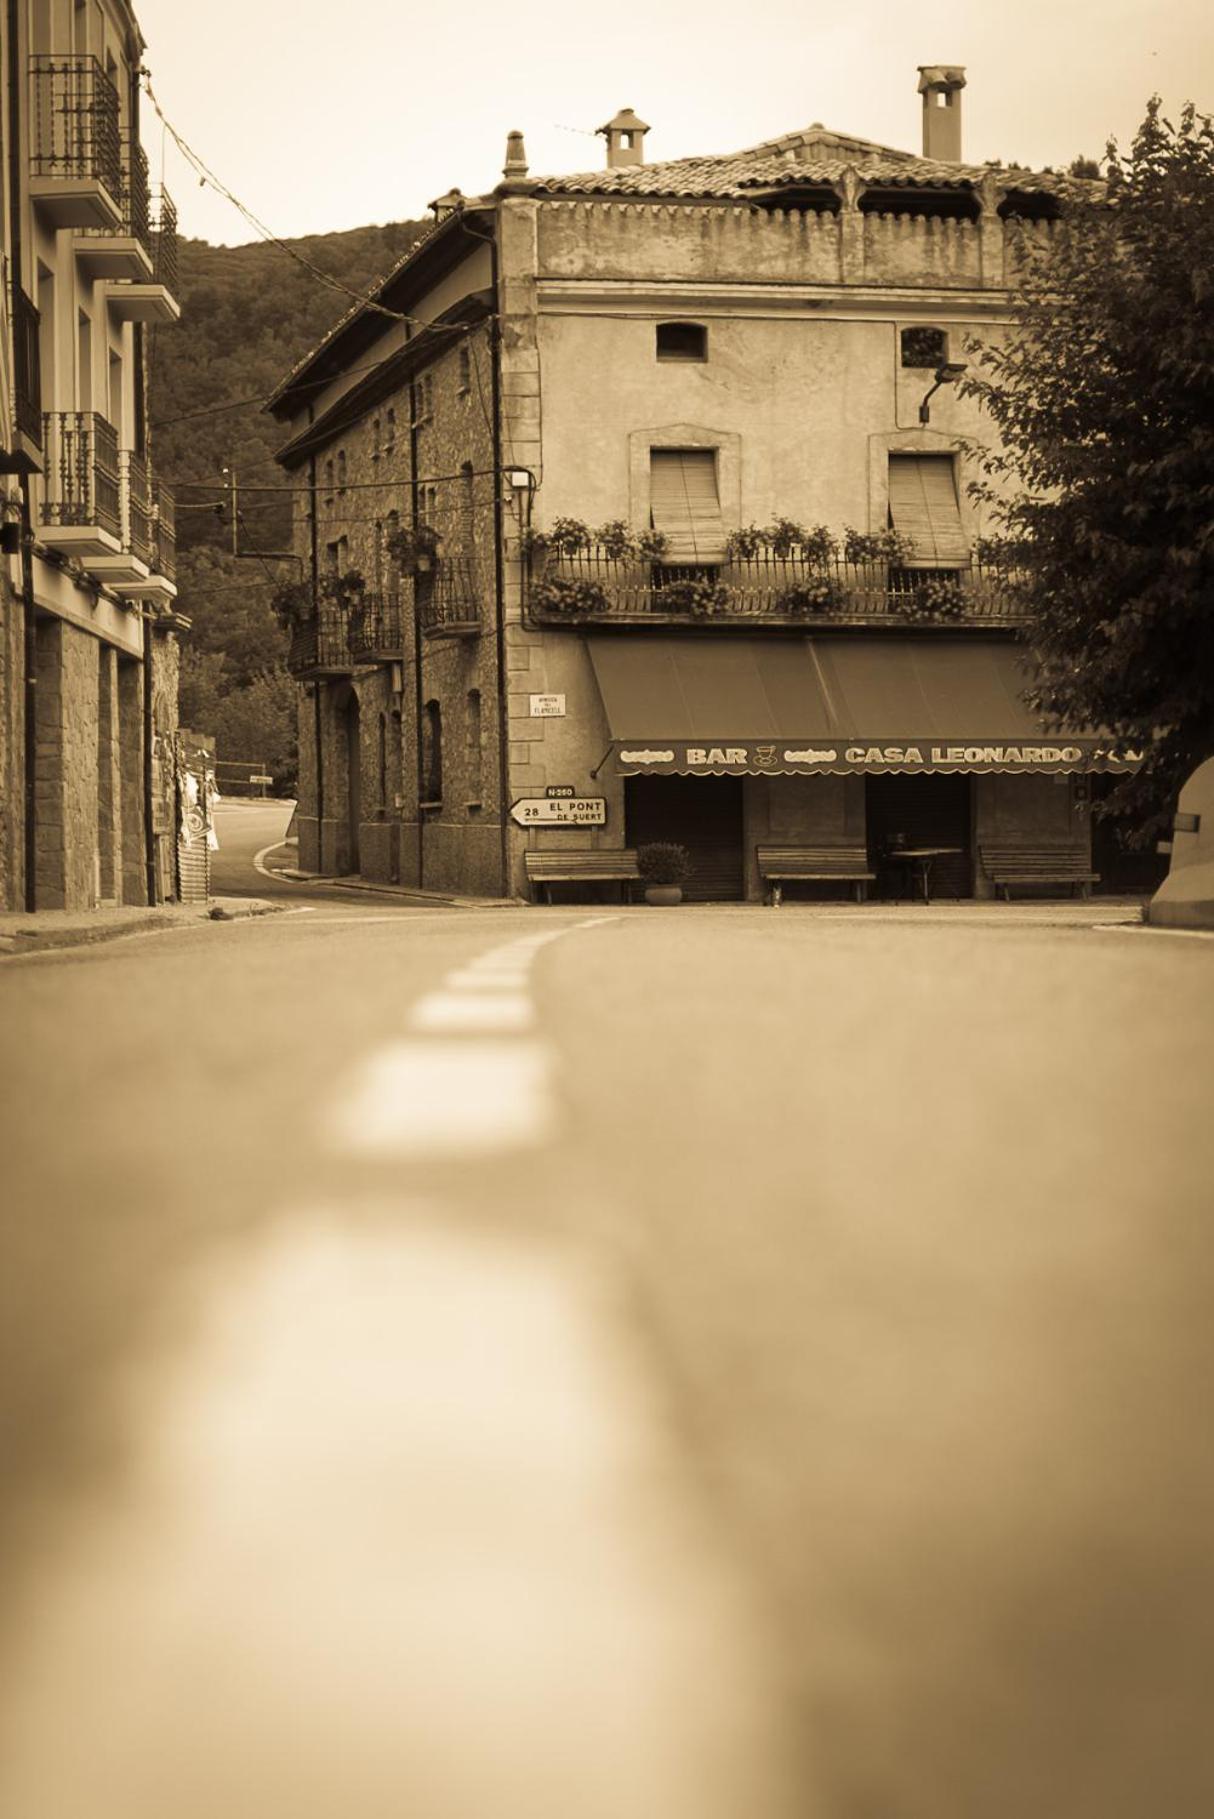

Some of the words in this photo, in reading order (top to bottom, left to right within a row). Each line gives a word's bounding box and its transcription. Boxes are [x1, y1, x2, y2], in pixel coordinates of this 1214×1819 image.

[686, 748, 748, 764] BAR
[845, 747, 923, 764] CASA
[931, 747, 1082, 763] LEONARDO
[550, 803, 563, 811] EL
[569, 802, 601, 811] PONT
[524, 808, 539, 816] 28
[573, 813, 602, 821] SUERT
